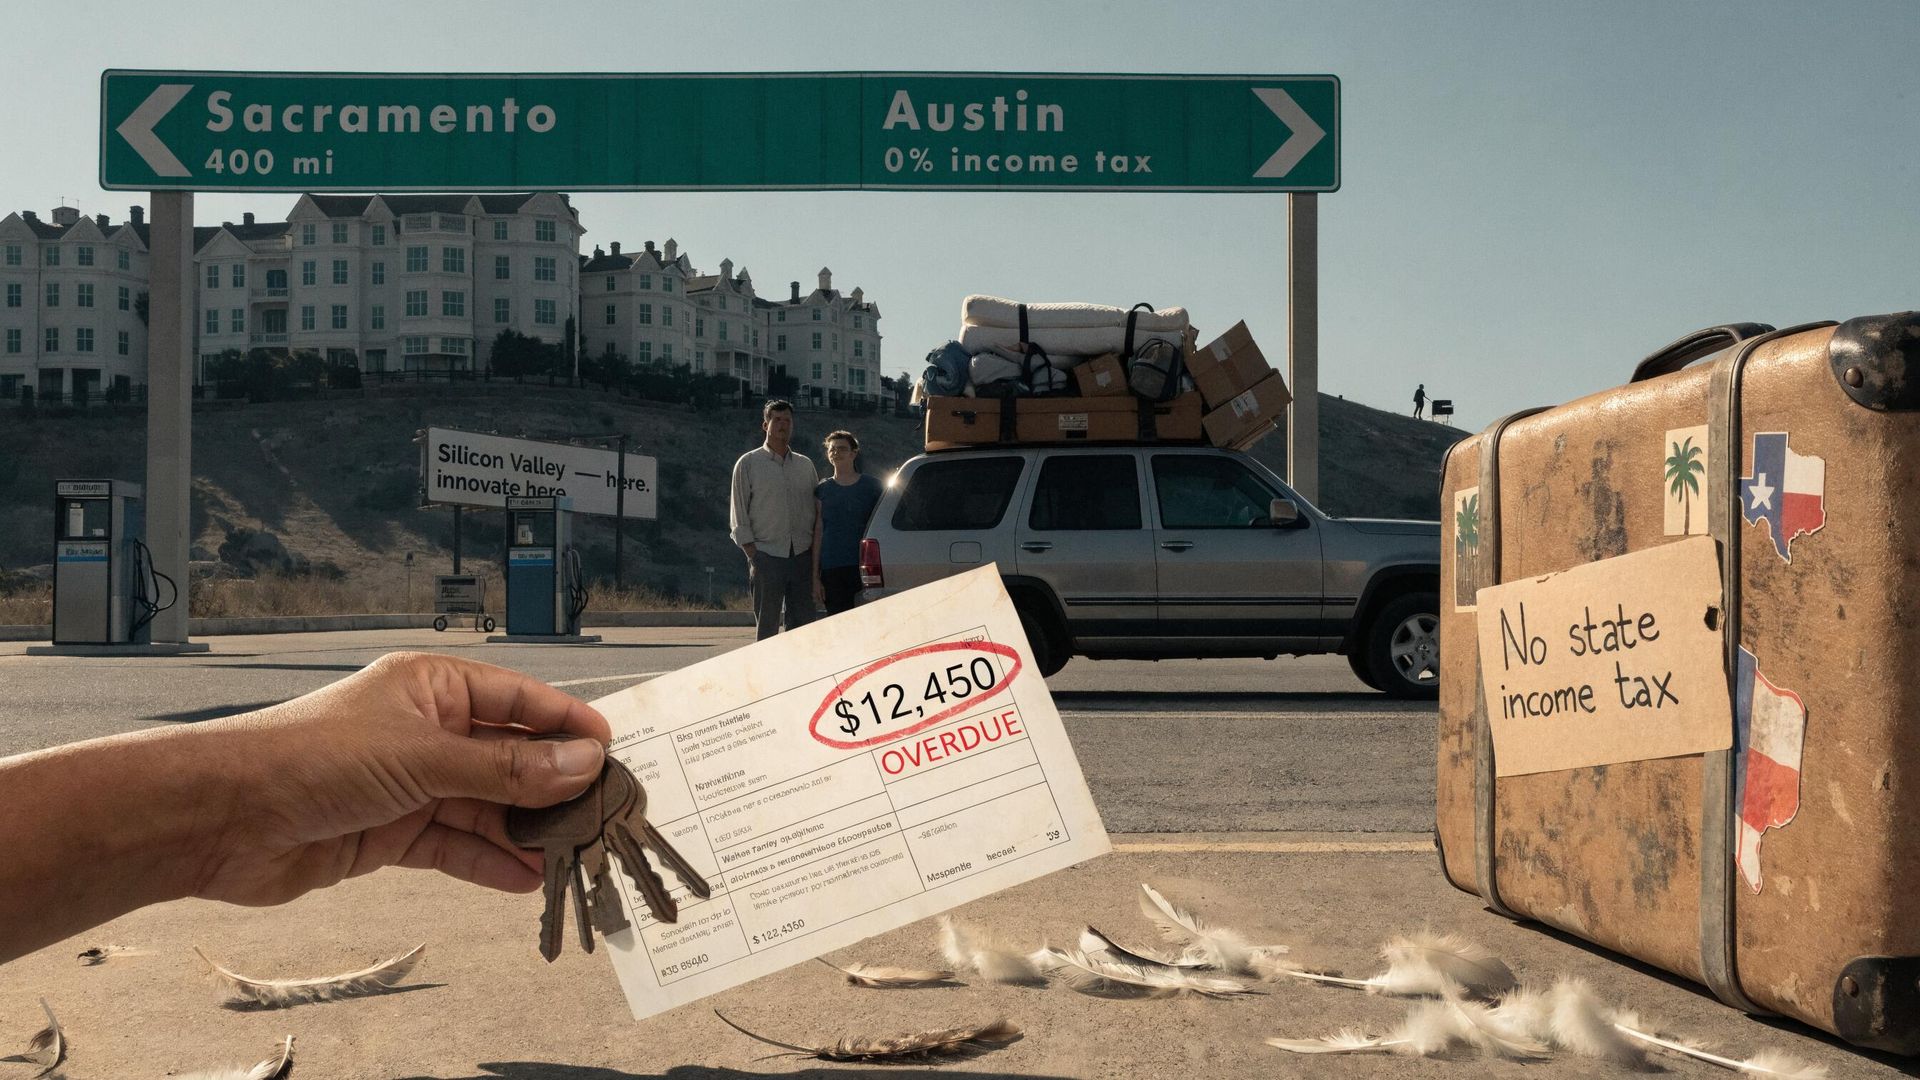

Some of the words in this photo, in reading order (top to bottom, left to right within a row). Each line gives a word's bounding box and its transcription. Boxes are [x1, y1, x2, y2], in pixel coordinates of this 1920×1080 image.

[205, 90, 557, 133] Sacramento
[882, 89, 1065, 132] Austin
[204, 148, 274, 175] 400
[293, 149, 334, 175] mi
[884, 146, 934, 173] 0%
[951, 146, 1079, 173] income
[1095, 150, 1153, 173] tax
[436, 469, 521, 496] innovate
[438, 443, 504, 469] Silicon
[510, 452, 566, 481] Valley
[1500, 602, 1547, 671] No
[1569, 603, 1660, 657] state
[834, 656, 996, 736] $12,450
[1501, 684, 1597, 720] income
[1614, 660, 1679, 709] tax
[881, 711, 1022, 776] OVERDUE
